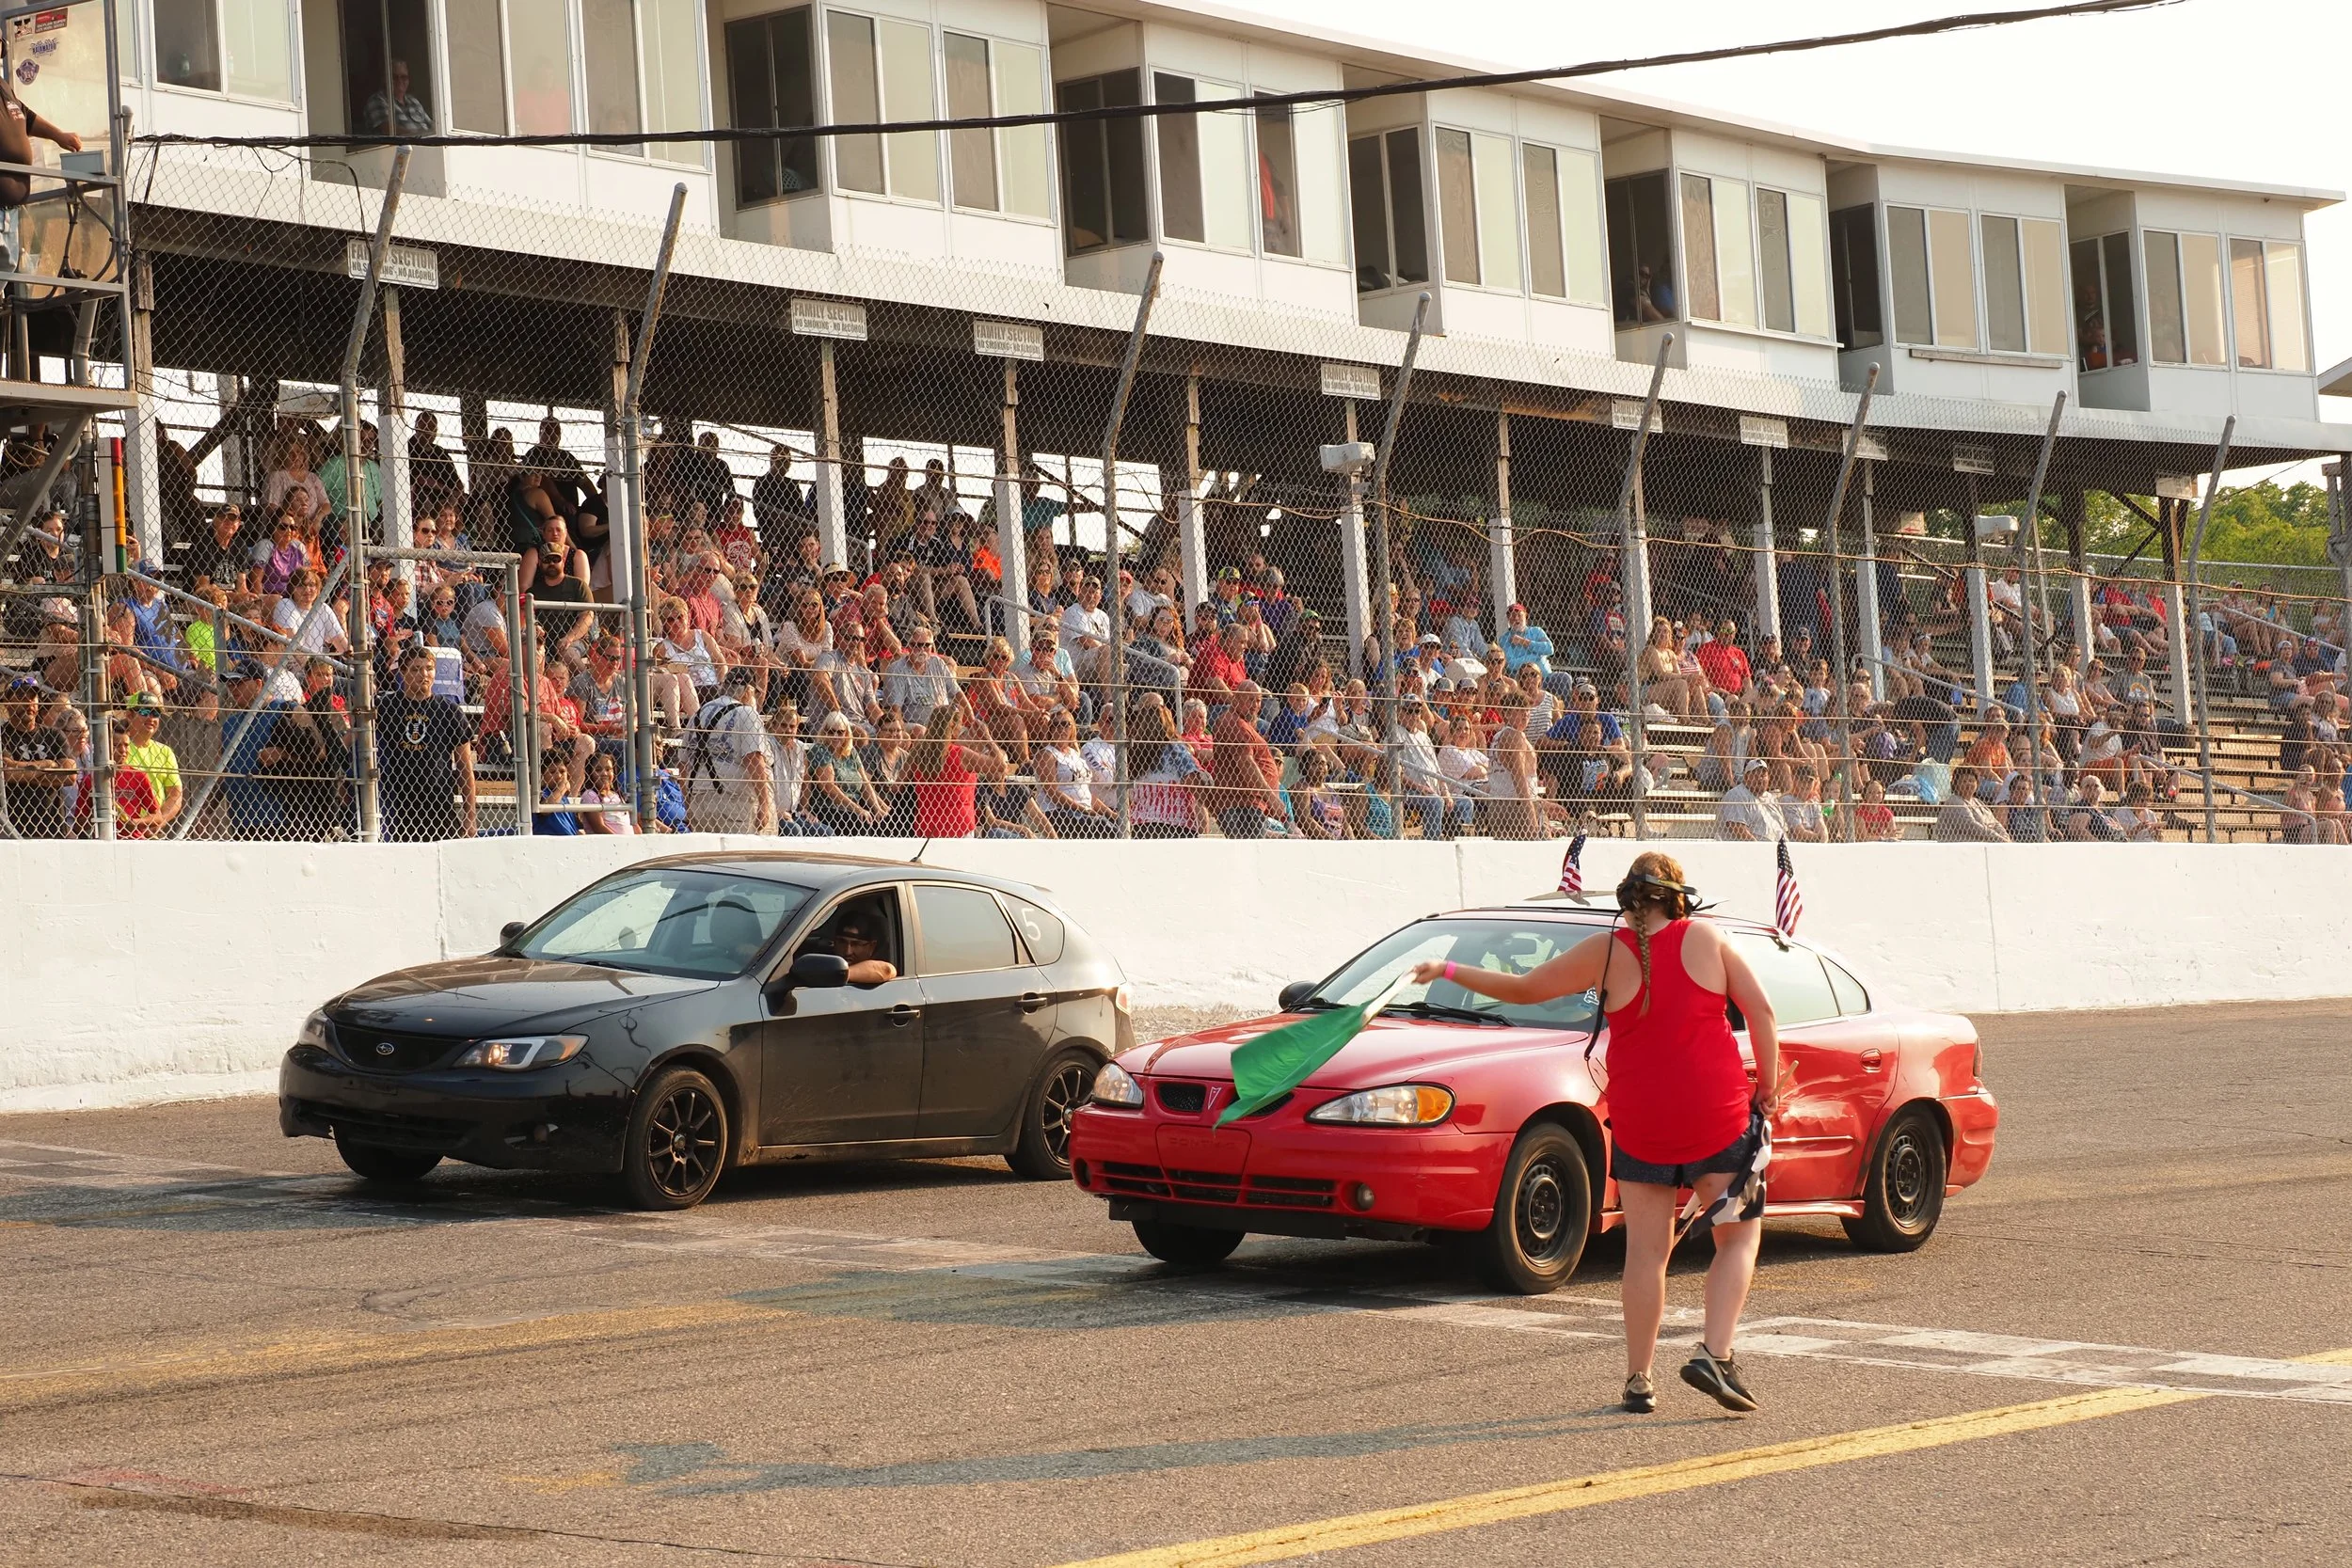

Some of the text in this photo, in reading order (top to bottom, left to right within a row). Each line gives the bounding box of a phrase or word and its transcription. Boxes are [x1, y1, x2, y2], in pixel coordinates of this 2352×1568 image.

[390, 247, 434, 271] SECTION
[353, 261, 362, 272] NO
[398, 267, 407, 277] NO
[407, 268, 435, 282] ALCOHOL
[795, 303, 865, 323] FAMILY SECTION
[795, 318, 803, 327] NO
[804, 318, 829, 330] SMOKING
[833, 322, 841, 331] NO
[977, 325, 1041, 344] FAMILY SECTION
[1324, 366, 1349, 381] FAMILY
[1022, 908, 1041, 941] 5
